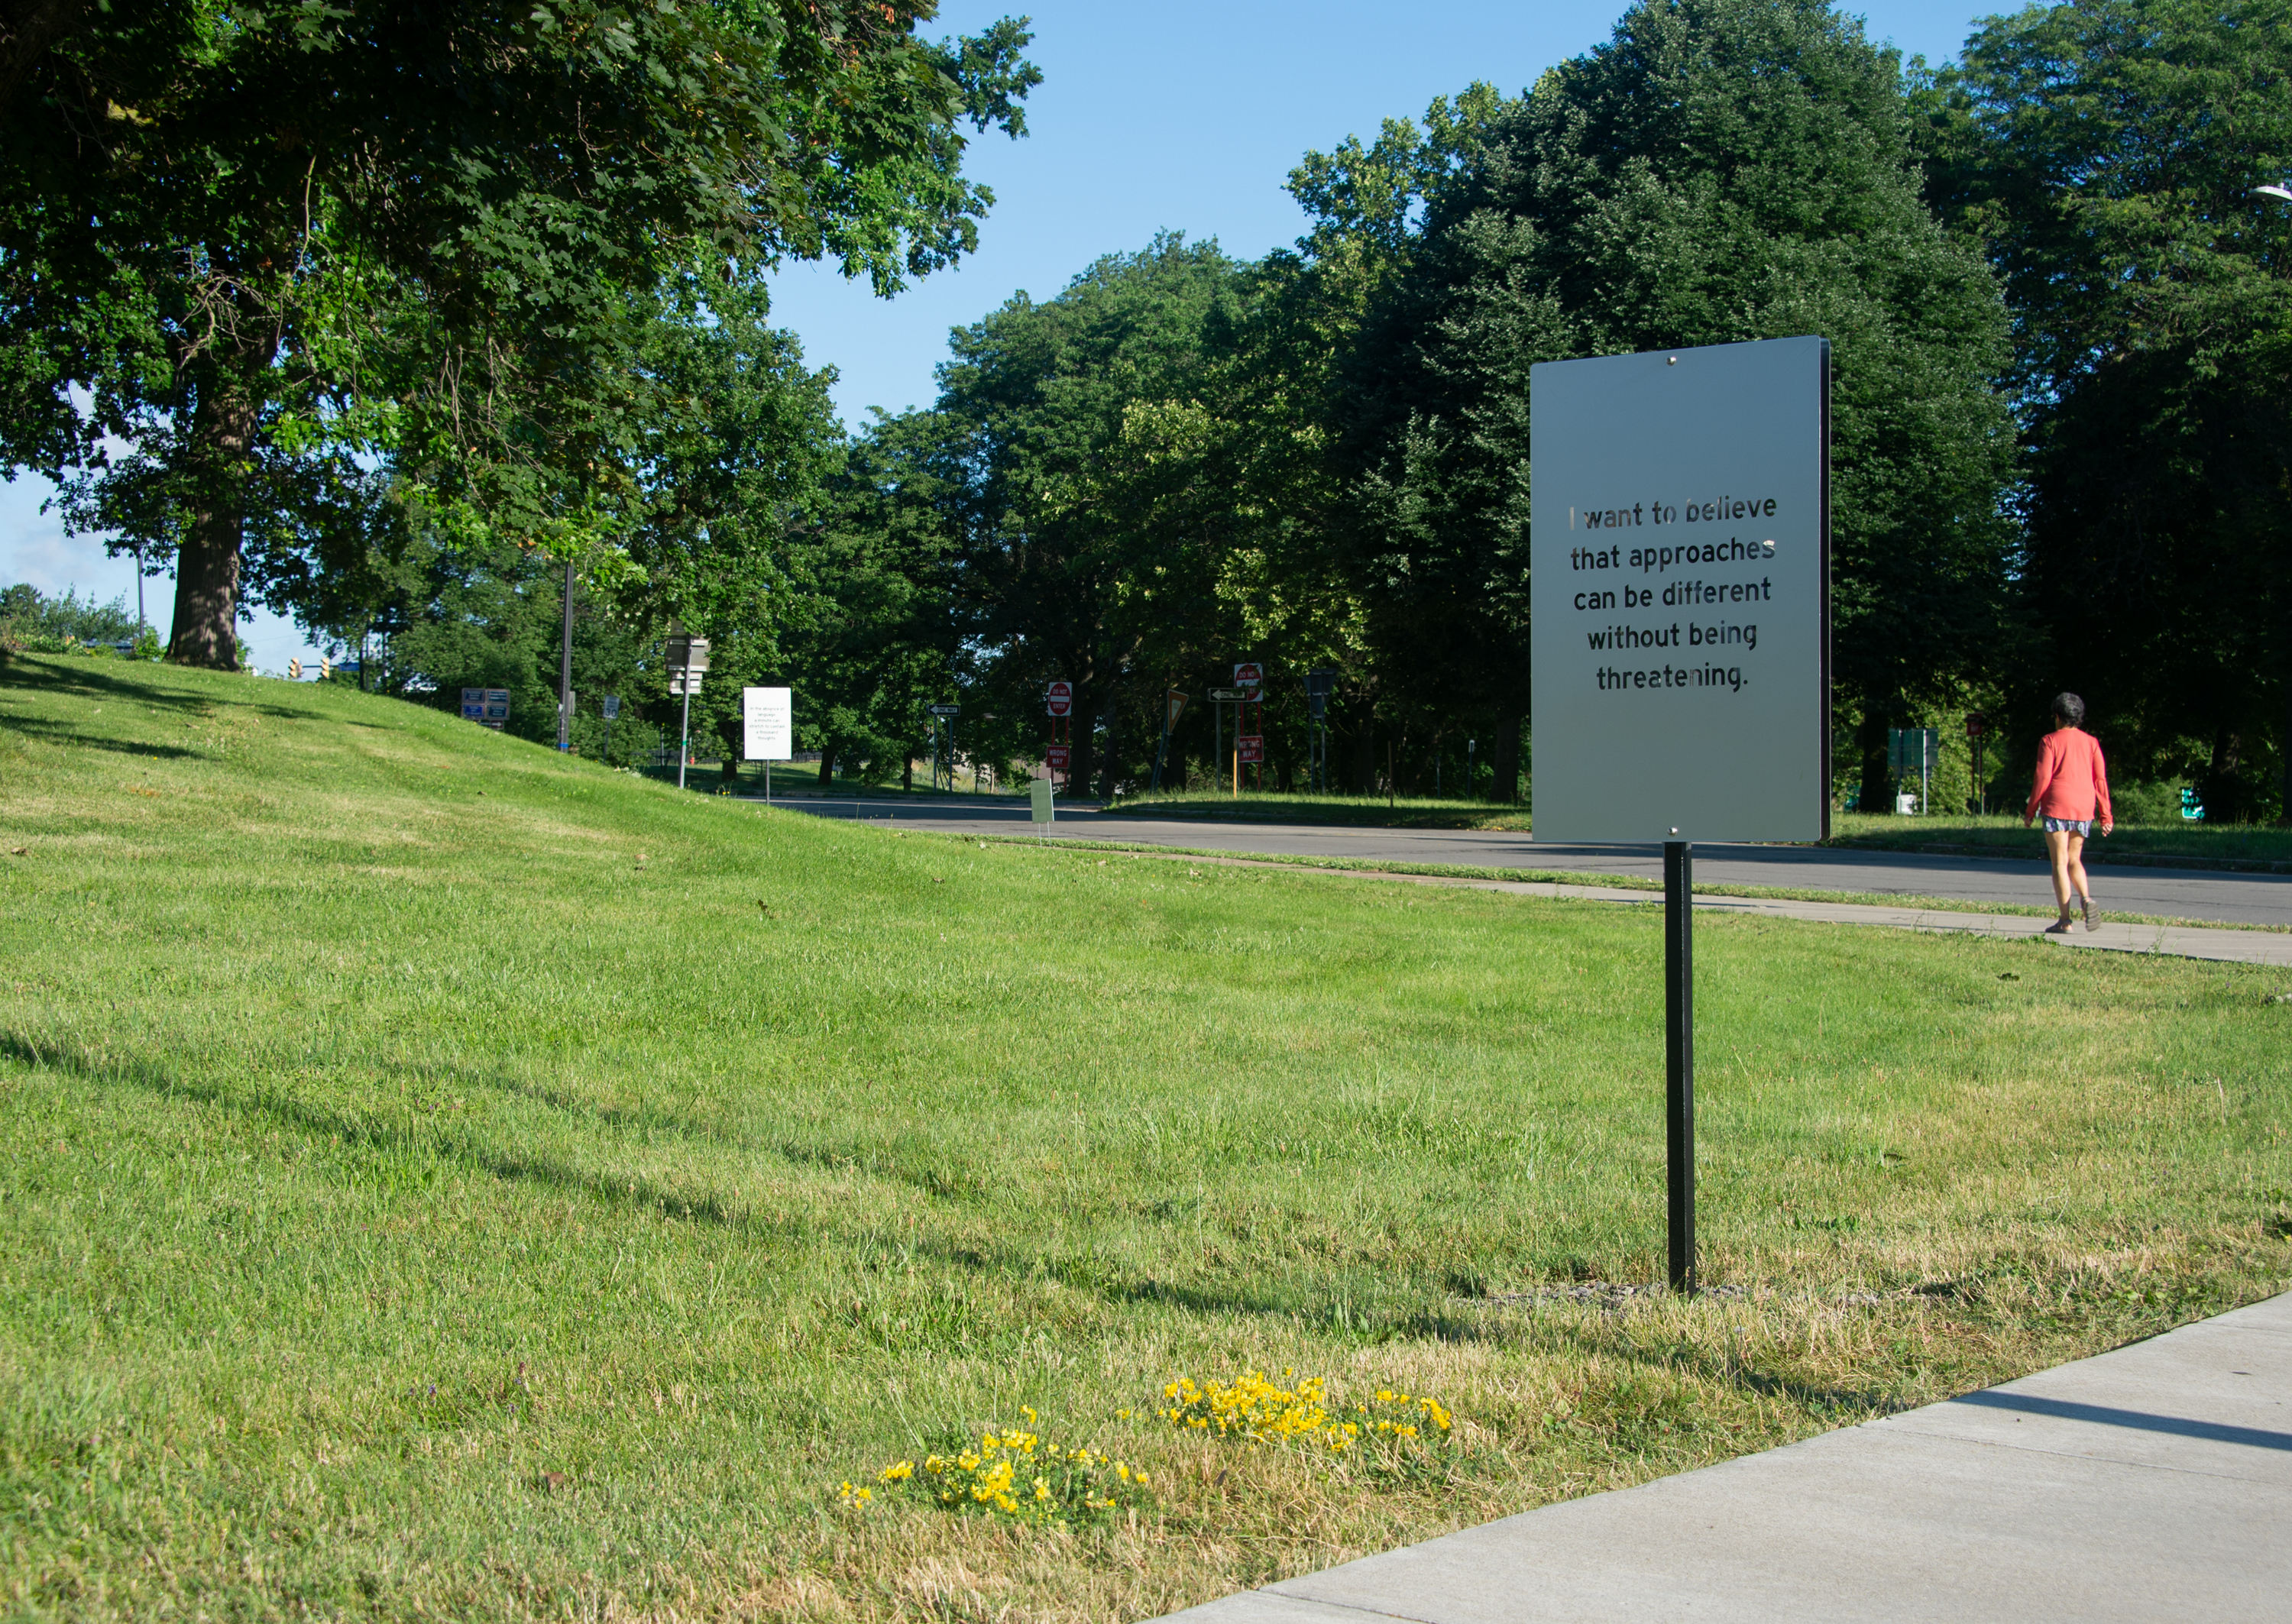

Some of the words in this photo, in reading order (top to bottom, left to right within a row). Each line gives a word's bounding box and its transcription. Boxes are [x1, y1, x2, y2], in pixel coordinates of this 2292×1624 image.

[1569, 506, 1575, 530] I
[1584, 502, 1643, 529] want
[1652, 500, 1677, 525] to
[1686, 496, 1777, 523] believe
[1571, 545, 1620, 571] that
[1630, 537, 1776, 574] approaches
[1574, 591, 1616, 611] can
[1624, 584, 1653, 609] be
[1662, 577, 1772, 607] different
[1588, 623, 1680, 651] without
[1689, 620, 1757, 652] being
[1597, 663, 1749, 694] threatening.
[605, 707, 617, 717] 30
